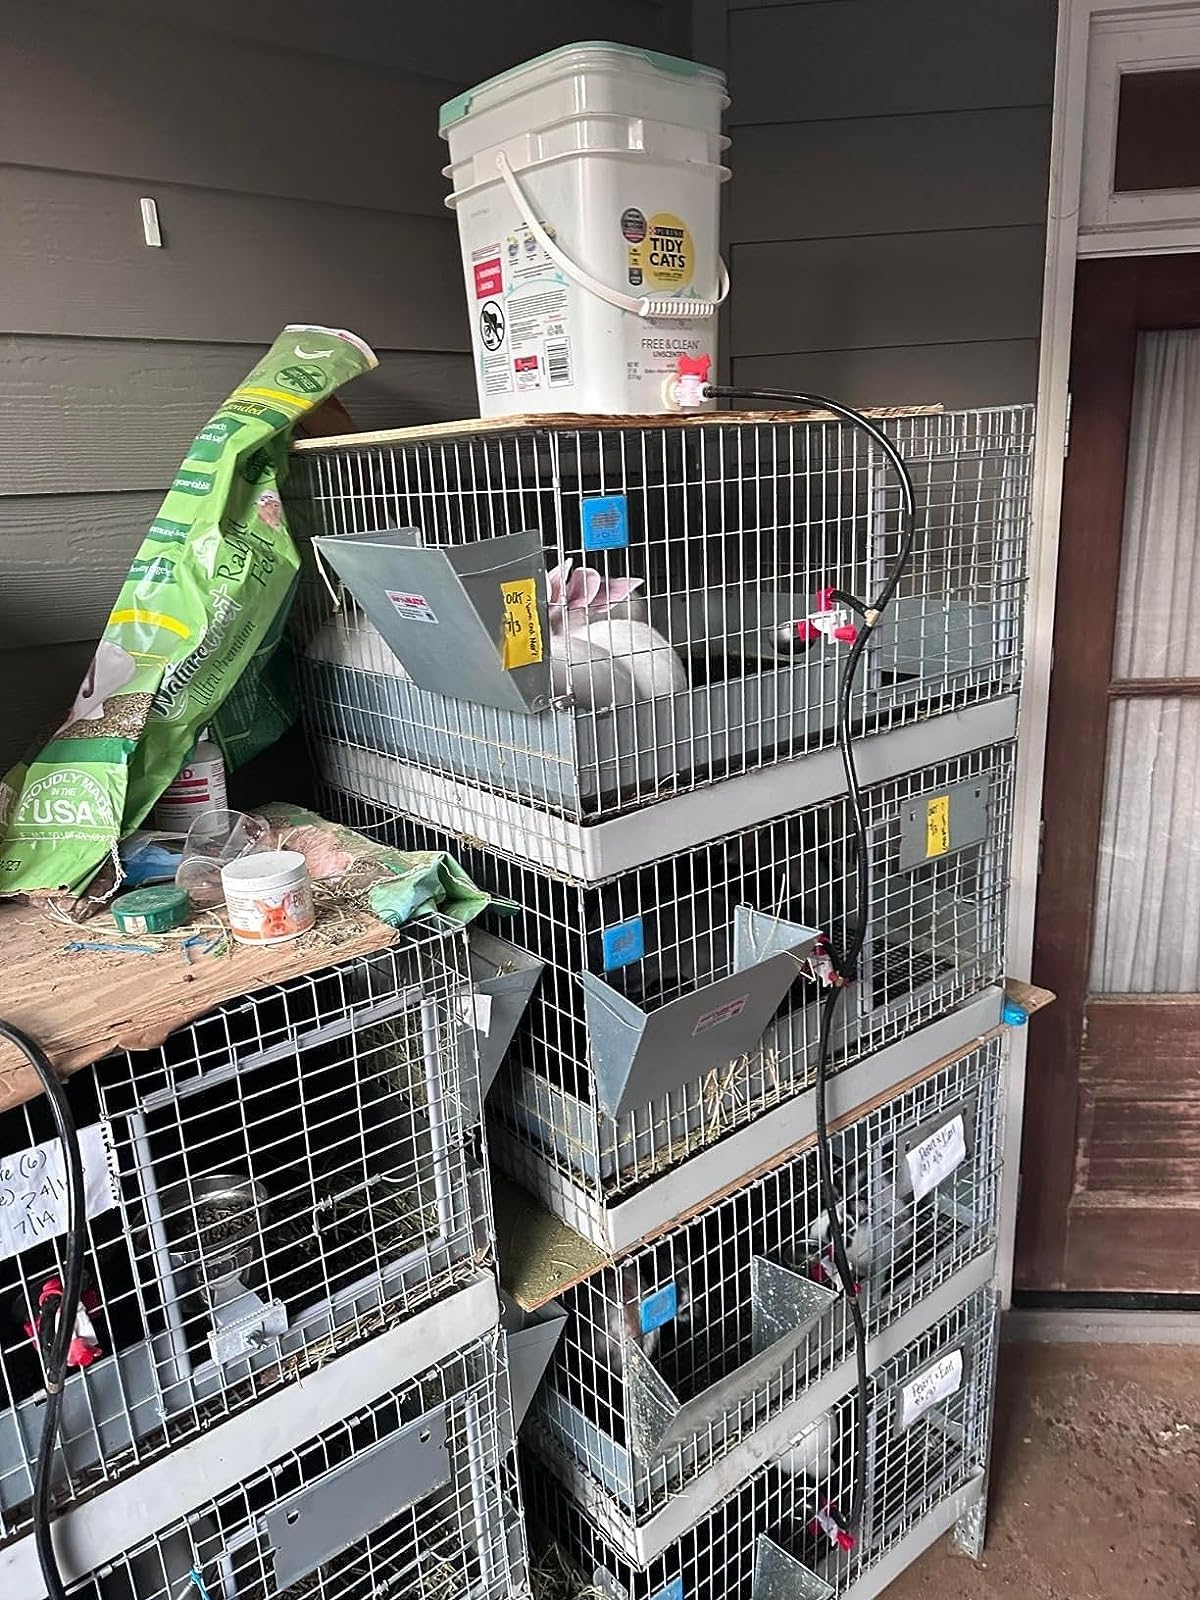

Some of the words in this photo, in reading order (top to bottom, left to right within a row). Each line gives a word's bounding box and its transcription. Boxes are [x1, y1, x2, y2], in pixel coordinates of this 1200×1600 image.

[650, 238, 683, 253] TIDY
[649, 252, 686, 268] CATS
[190, 678, 218, 706] Ultra
[213, 620, 256, 672] Premium
[17, 772, 82, 822] PROUDLY
[61, 787, 77, 797] THE
[32, 798, 96, 825] USA
[19, 1149, 47, 1179] (6)
[13, 1210, 56, 1236] 7/14
